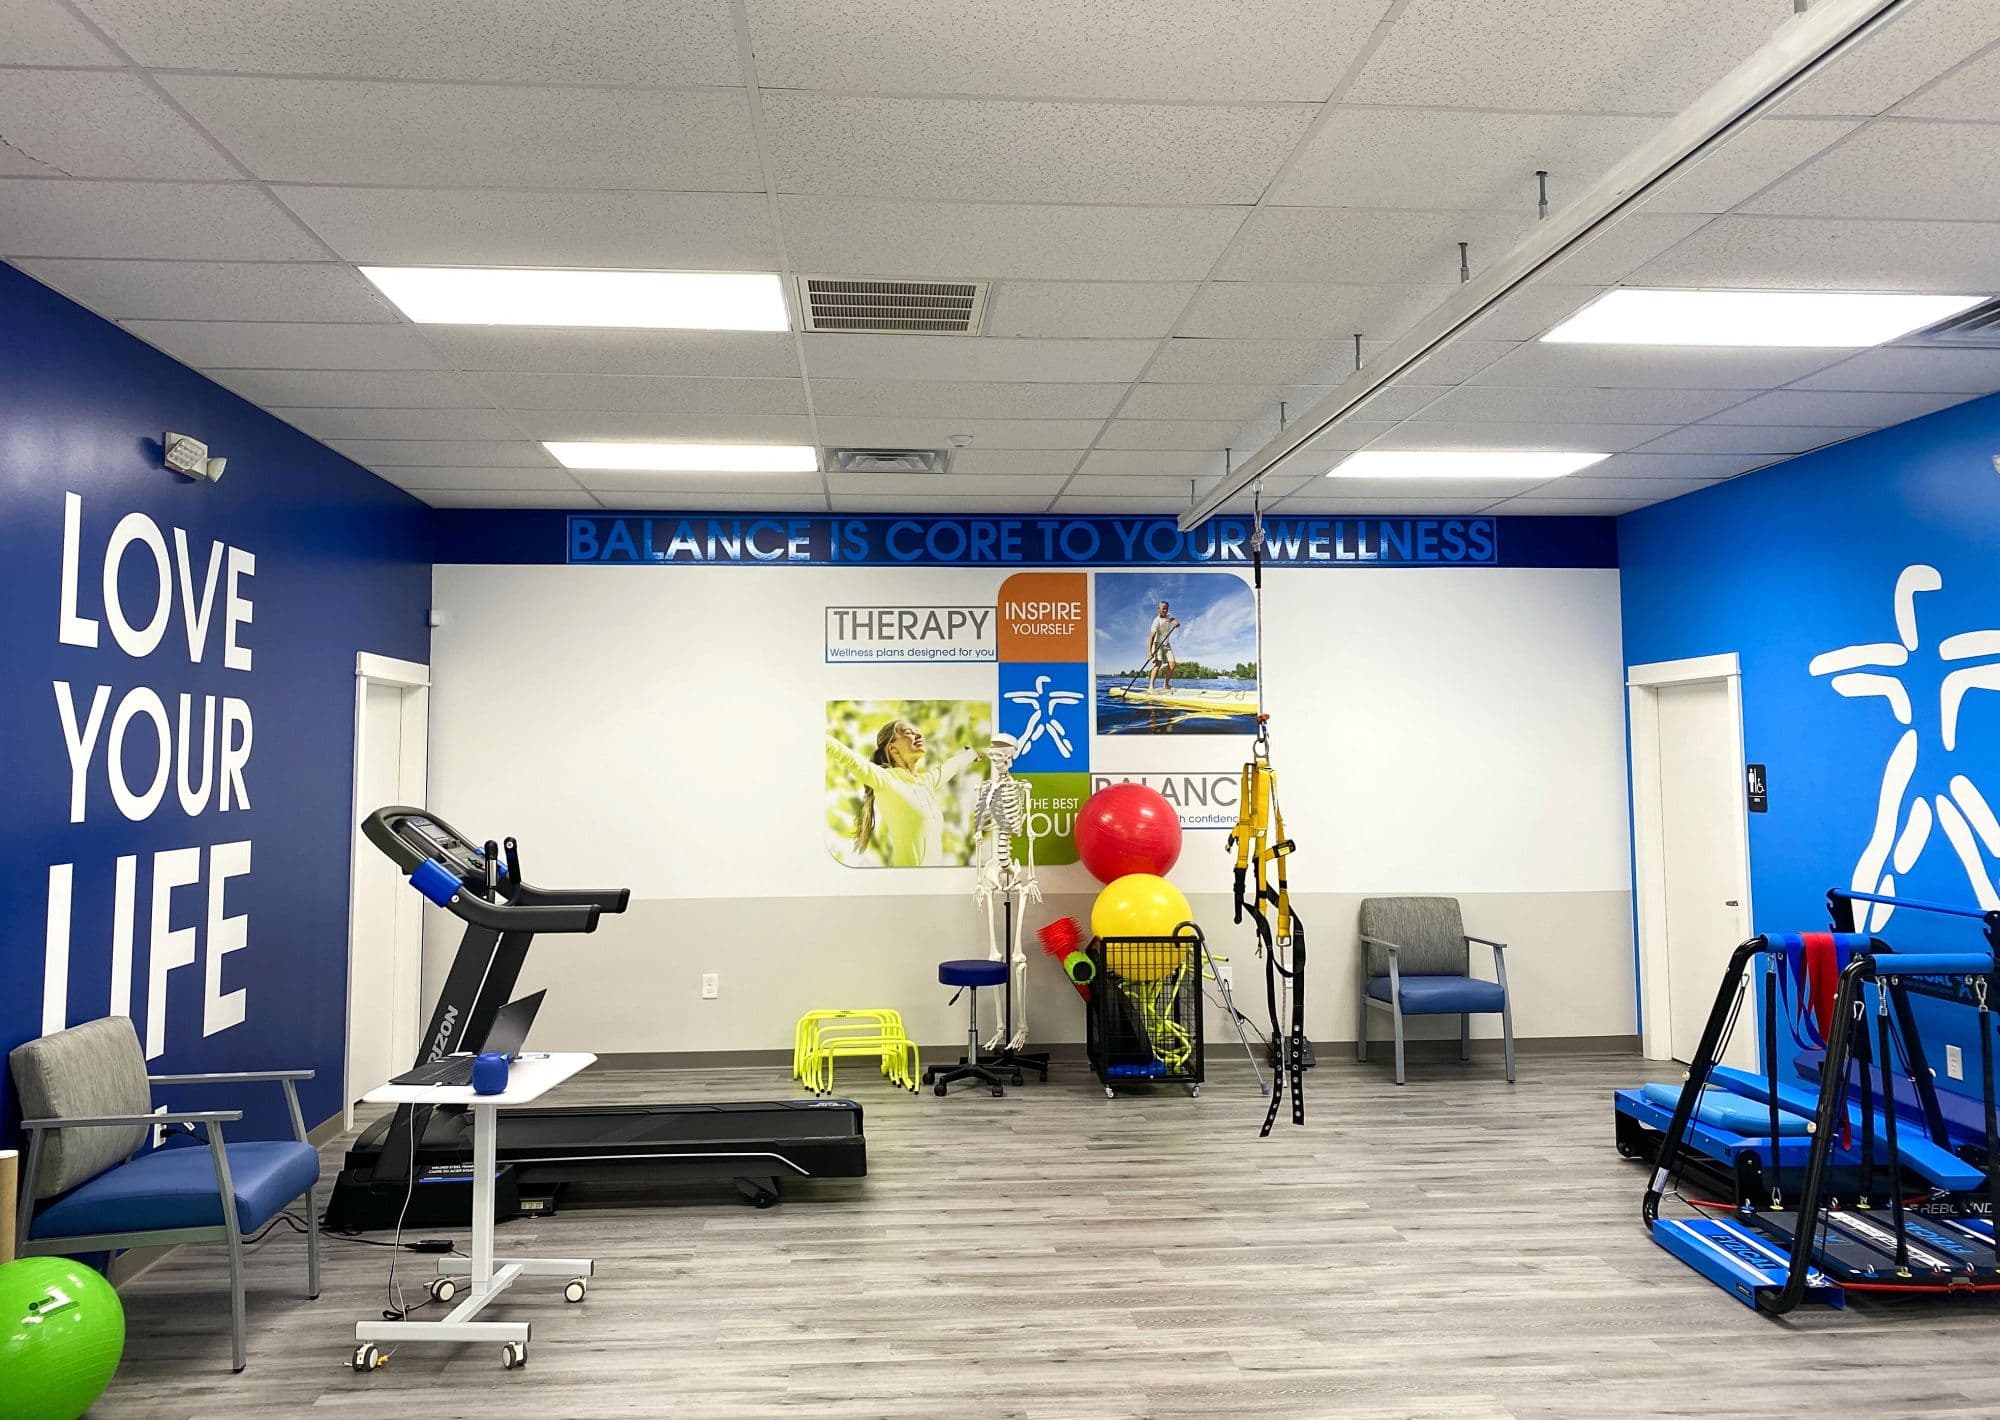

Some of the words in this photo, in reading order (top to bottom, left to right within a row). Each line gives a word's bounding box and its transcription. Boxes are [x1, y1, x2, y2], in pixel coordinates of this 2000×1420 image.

[572, 519, 811, 561] BALANCE
[831, 520, 869, 561] IS
[885, 520, 1022, 561] CORE
[1037, 520, 1101, 561] TO
[1112, 520, 1247, 561] YOUR
[1265, 520, 1494, 561] WELLNESS
[59, 491, 256, 671] LOVE
[833, 610, 990, 641] THERAPY
[1005, 601, 1082, 621] INSPIRE
[1012, 623, 1076, 636] YOURSELF
[830, 647, 874, 657] Wellness
[876, 647, 905, 658] plans
[907, 647, 956, 659] designed
[958, 647, 972, 657] for
[975, 649, 994, 658] you
[53, 680, 254, 823] YOUR
[1053, 798, 1079, 809] BEST
[1188, 814, 1238, 823] confidenc
[41, 840, 252, 1060] LIFE
[427, 1004, 459, 1064] RIZON
[1709, 1234, 1777, 1269] FYZICAL
